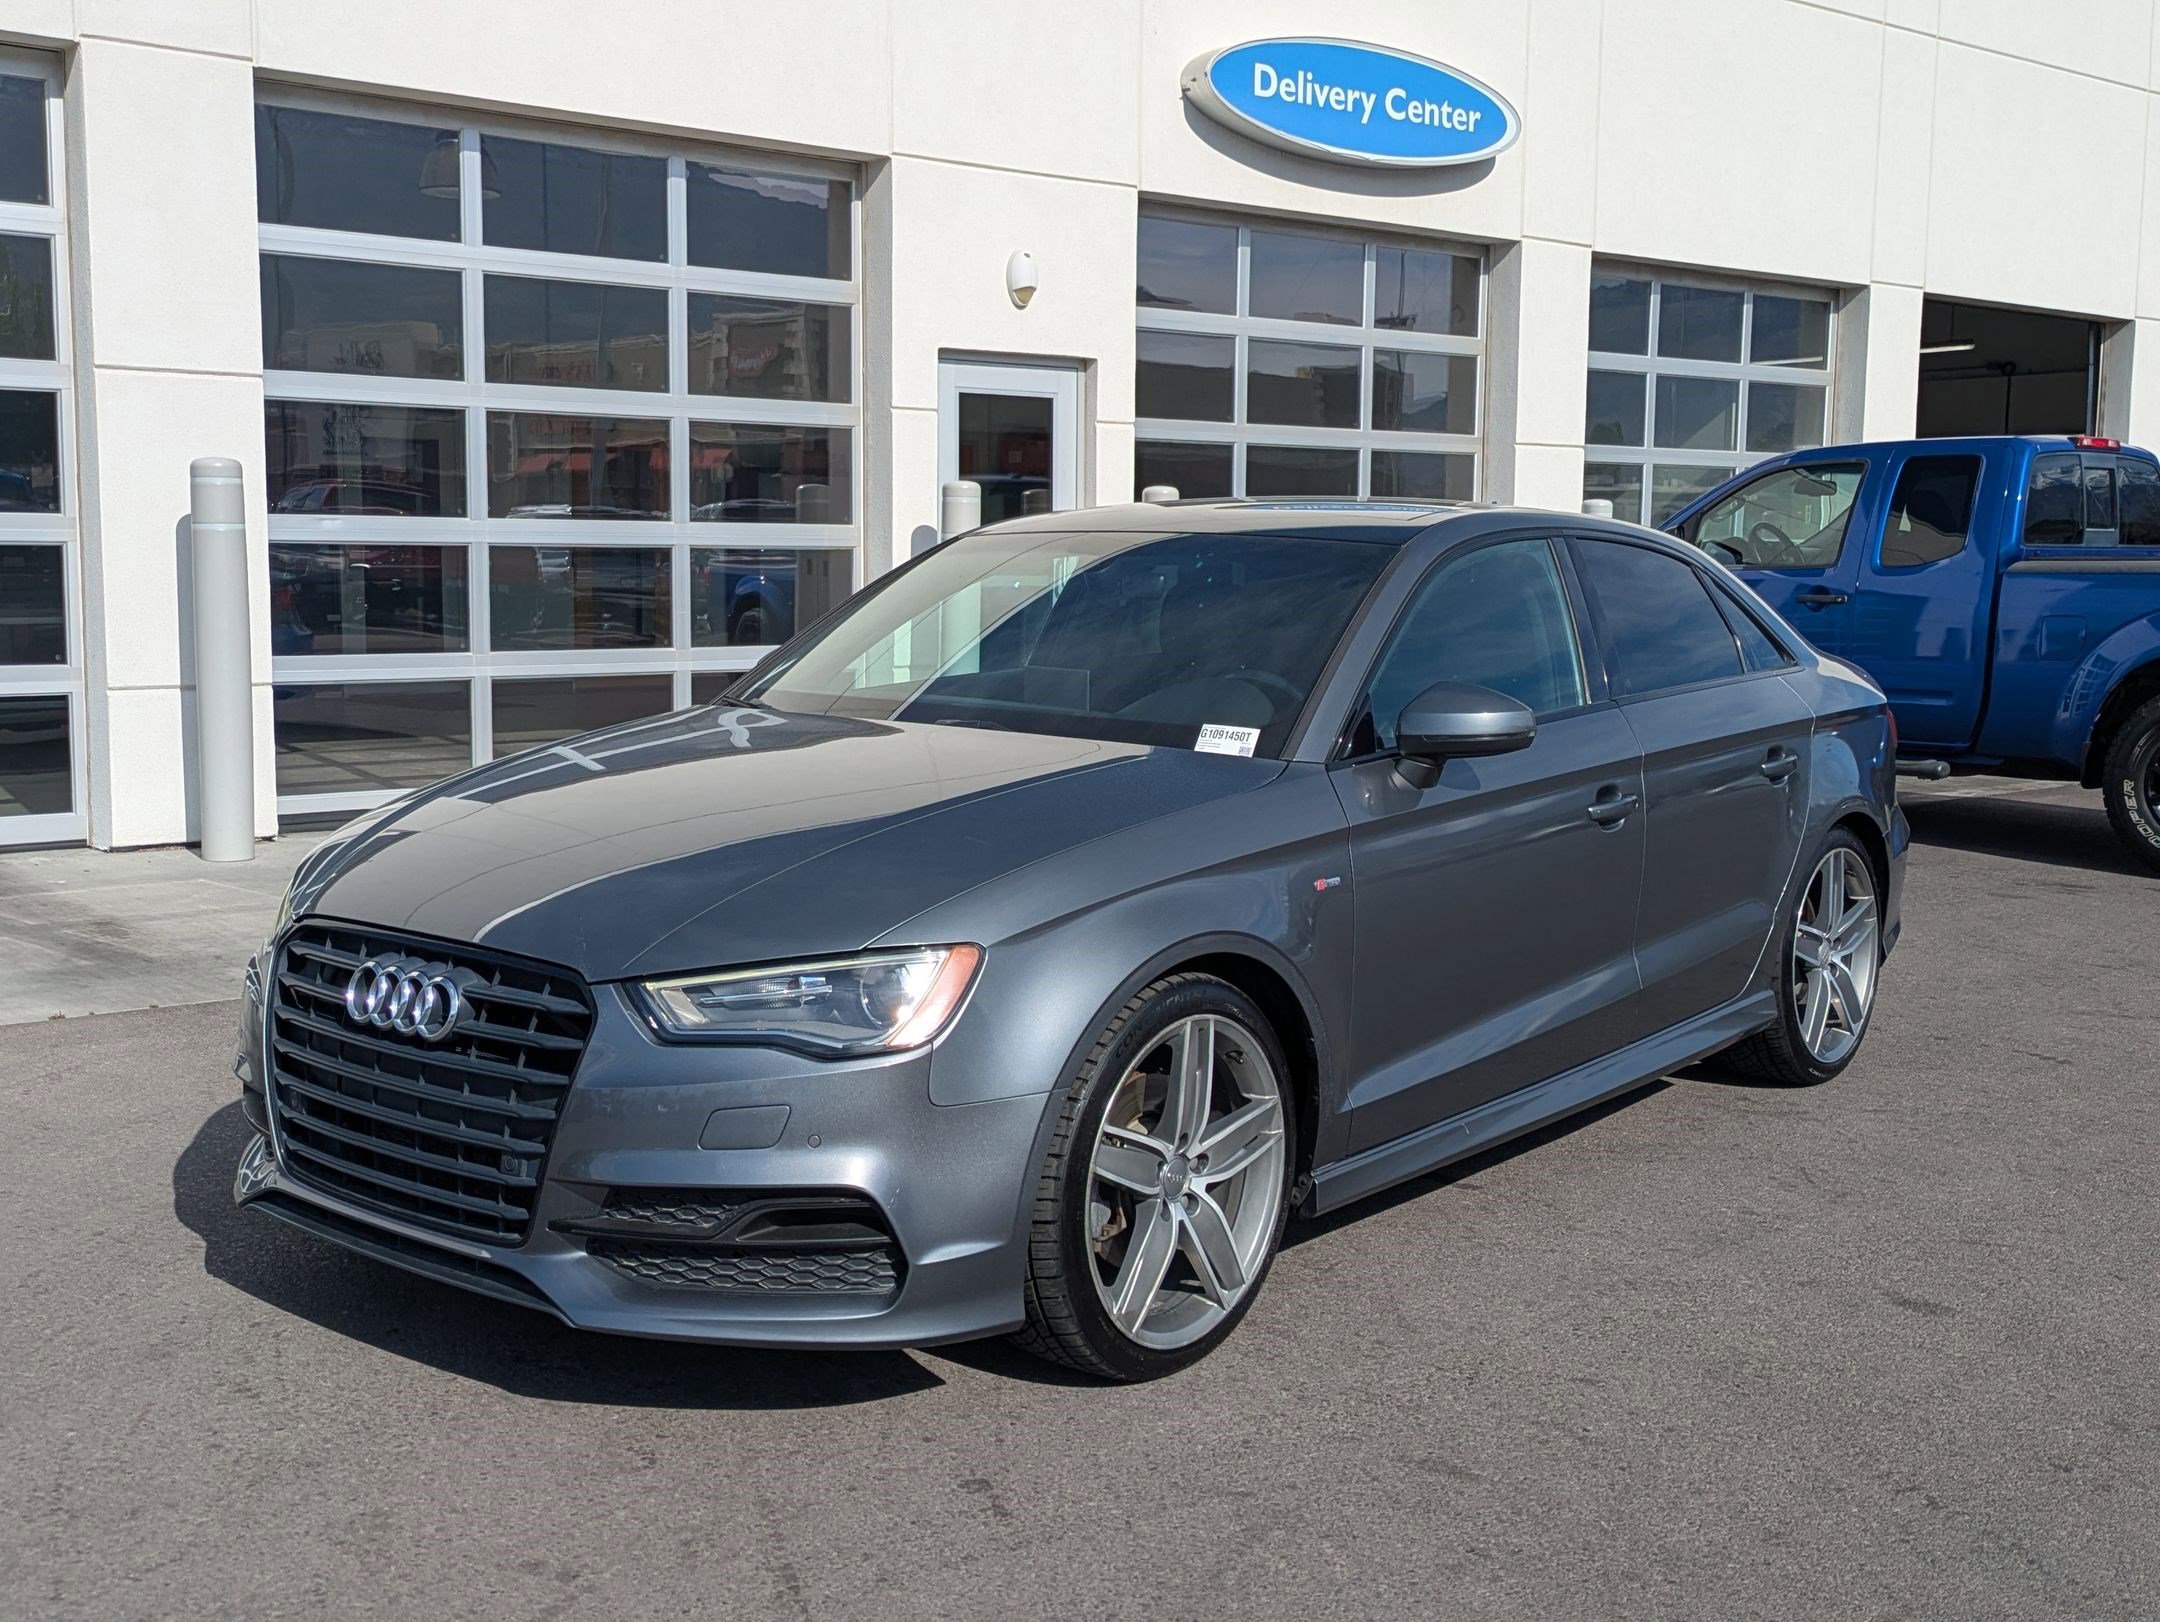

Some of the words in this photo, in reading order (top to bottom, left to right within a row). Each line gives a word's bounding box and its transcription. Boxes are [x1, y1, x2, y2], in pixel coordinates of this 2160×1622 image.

[1254, 63, 1376, 124] Delivery
[1385, 88, 1481, 132] Center
[1200, 728, 1253, 742] G1091450T
